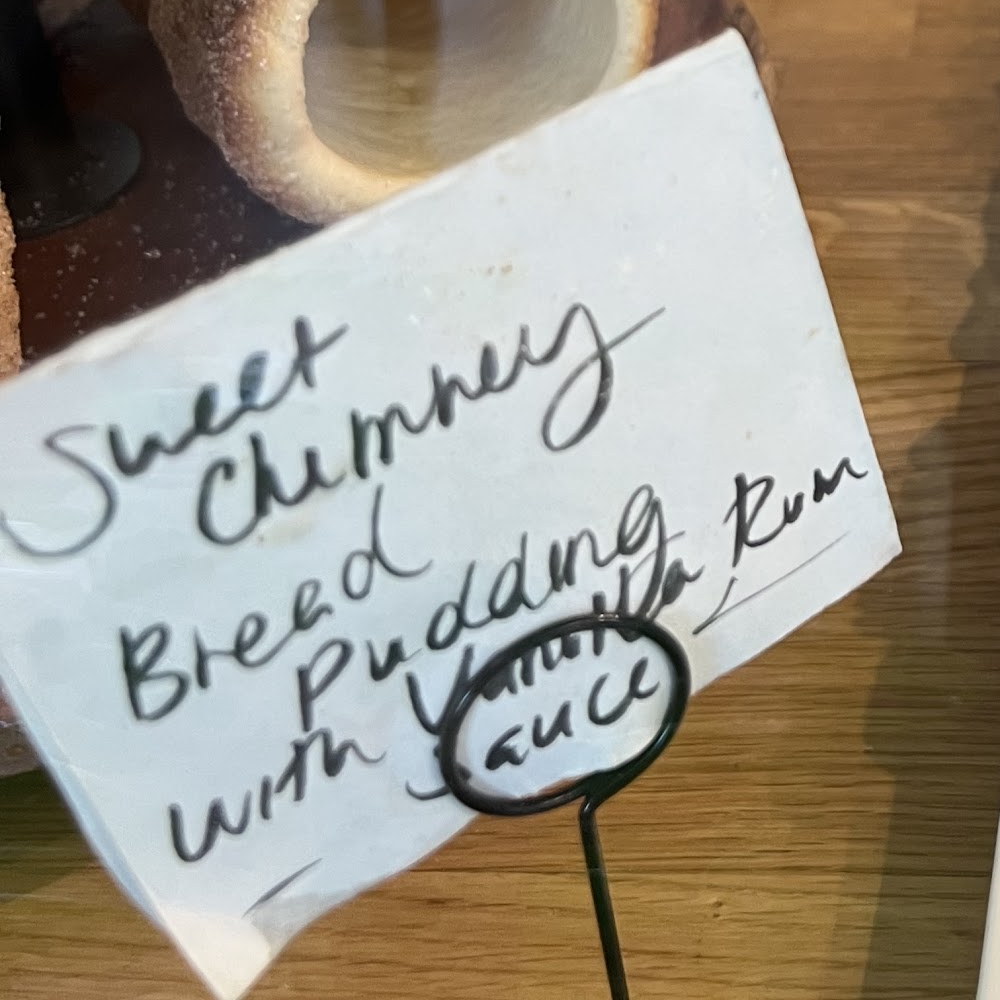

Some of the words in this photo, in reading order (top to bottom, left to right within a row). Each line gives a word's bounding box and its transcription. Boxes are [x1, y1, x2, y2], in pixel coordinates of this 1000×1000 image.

[2, 316, 349, 557] Sweet
[196, 303, 666, 545] Chimney
[723, 456, 869, 568] Rum
[119, 483, 434, 722] Bread
